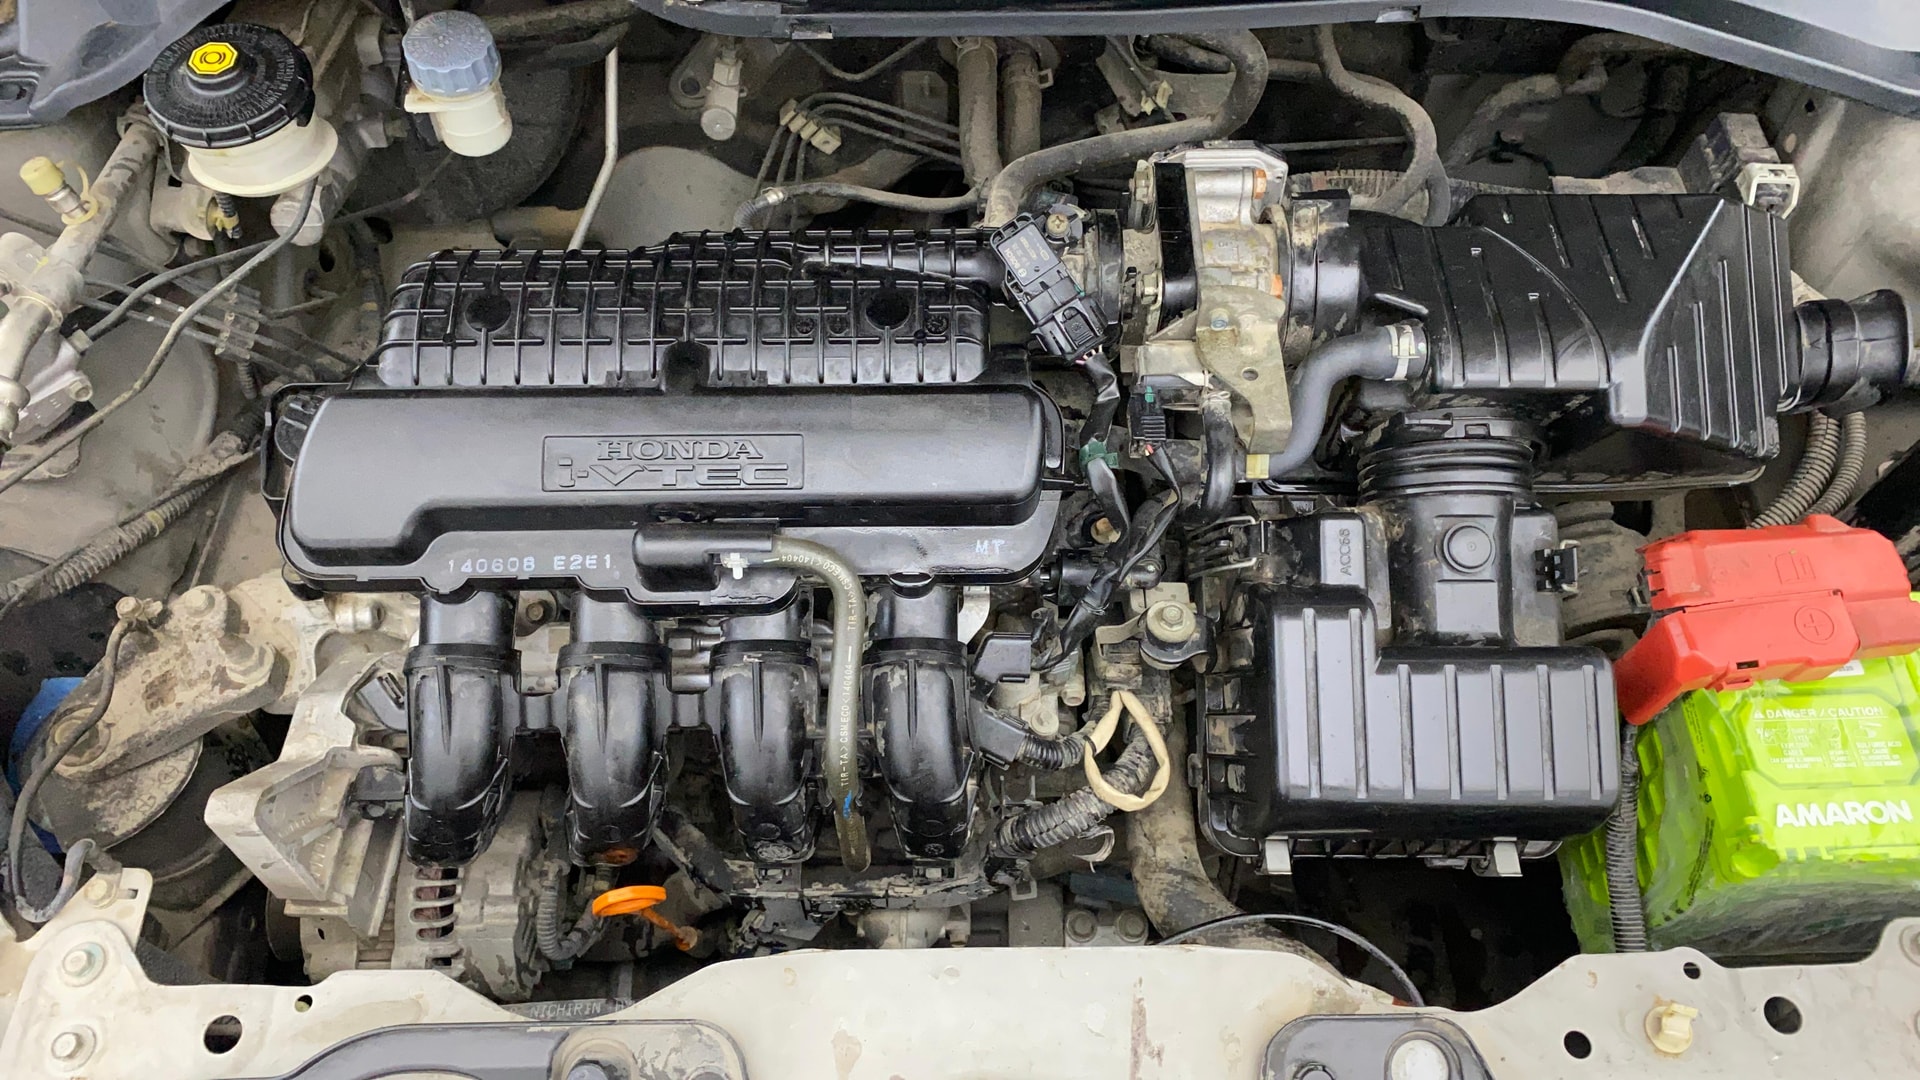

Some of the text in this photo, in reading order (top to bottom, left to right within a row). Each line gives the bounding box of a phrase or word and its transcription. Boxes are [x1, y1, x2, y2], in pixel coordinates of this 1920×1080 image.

[597, 439, 764, 461] HONDA
[557, 456, 789, 488] i-VTEC
[553, 553, 612, 571] E2E1
[1765, 708, 1817, 719] DANGER
[1827, 706, 1884, 718] CAUTION
[1776, 799, 1914, 828] AMARON
[529, 1002, 601, 1018] NICHIRIN
